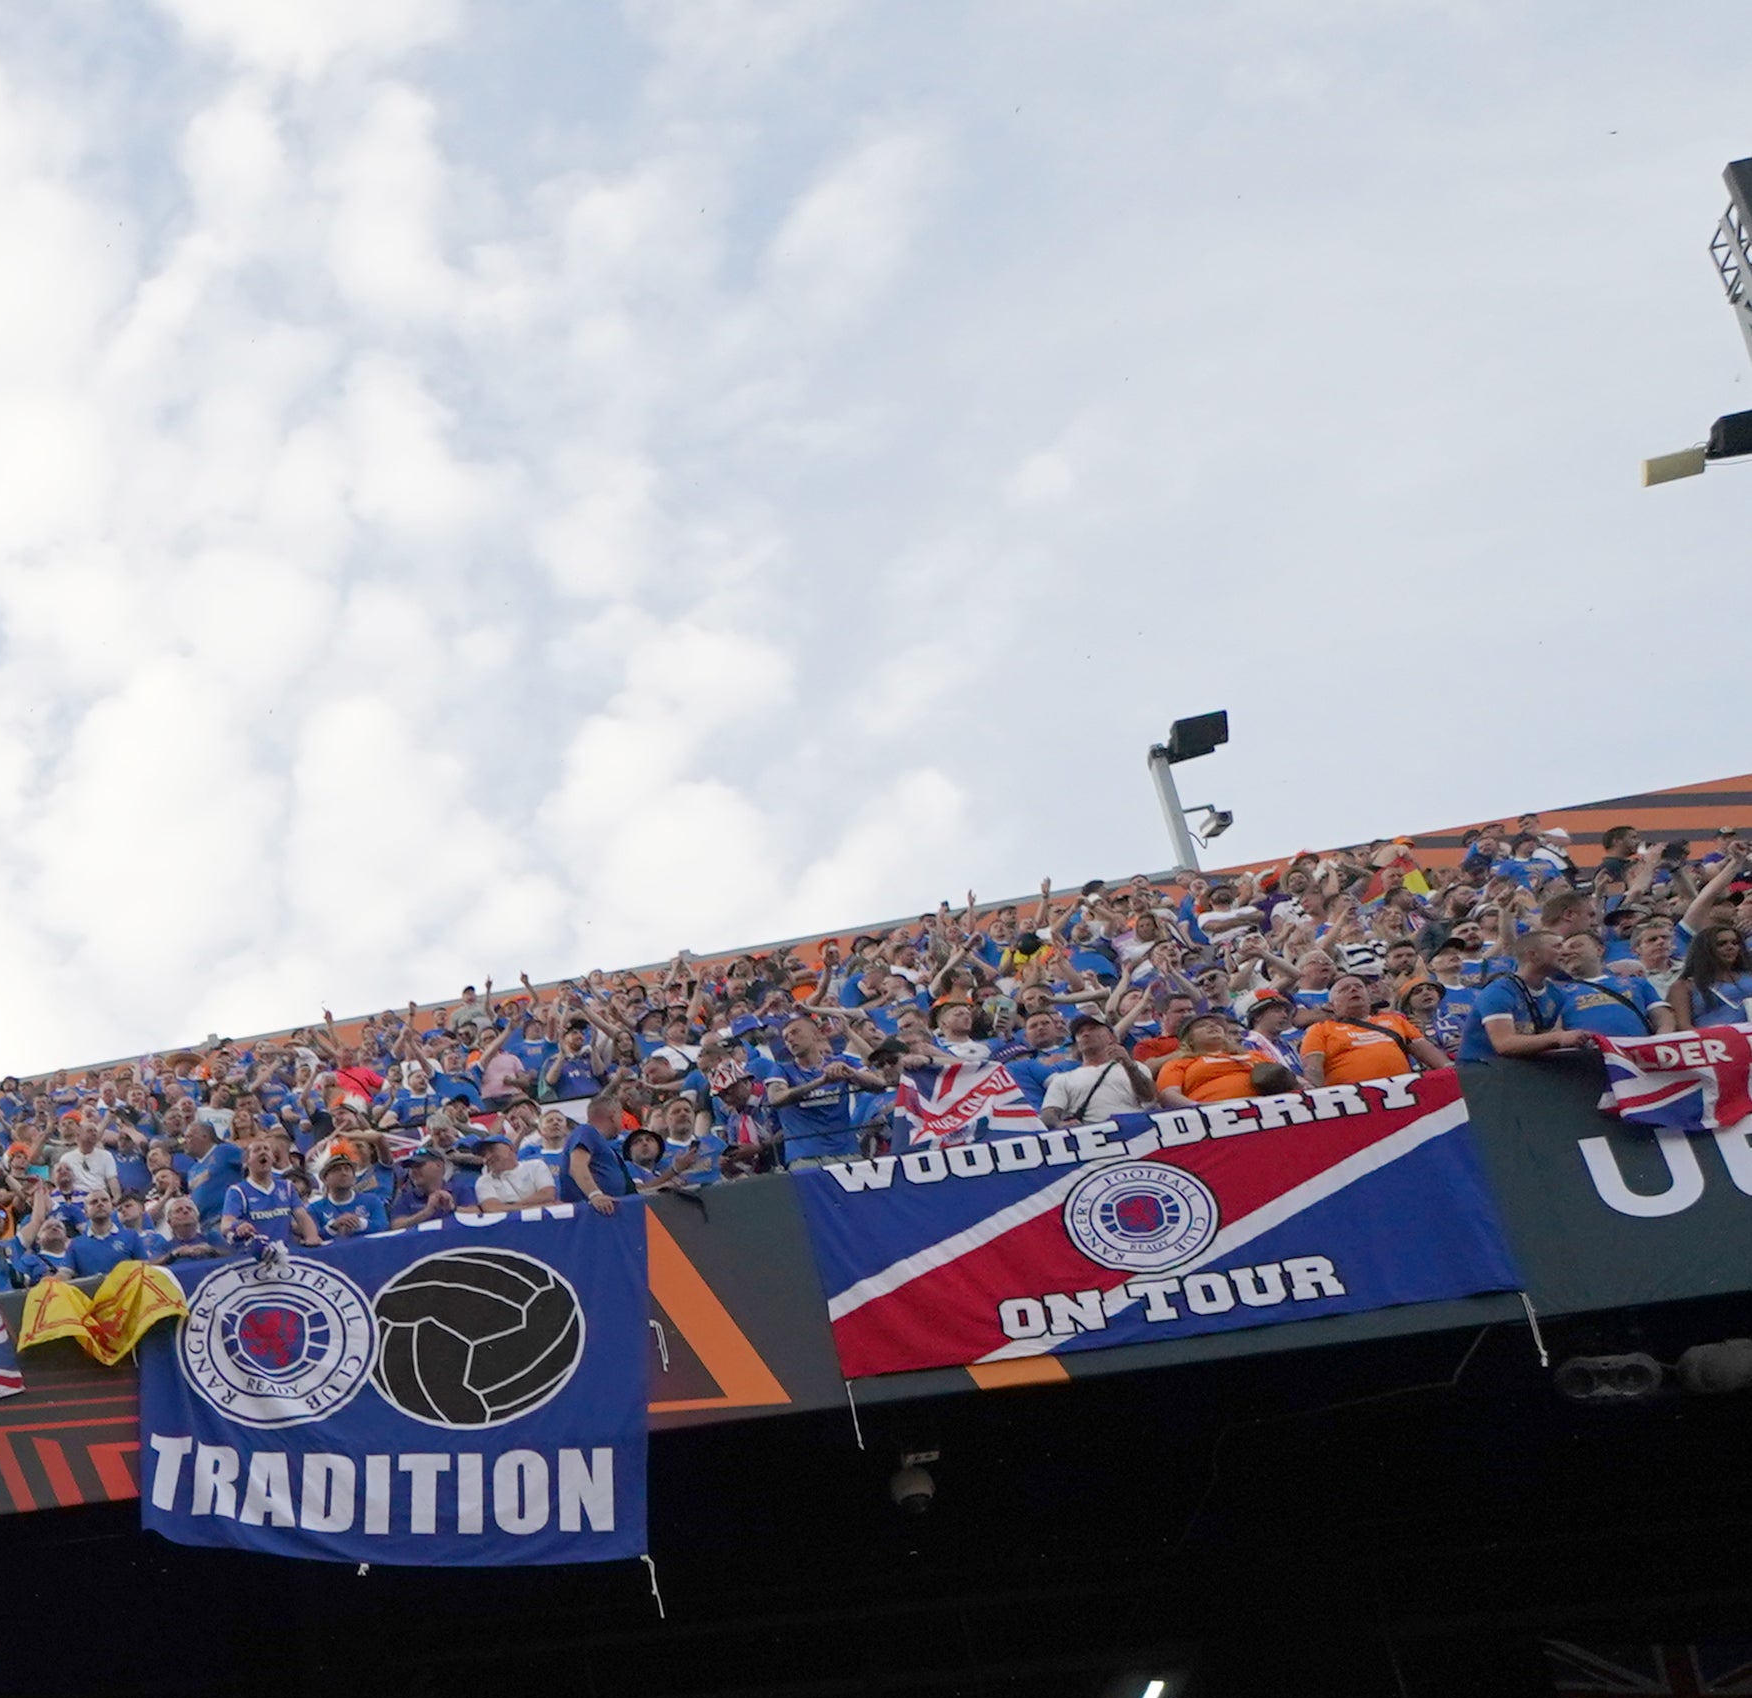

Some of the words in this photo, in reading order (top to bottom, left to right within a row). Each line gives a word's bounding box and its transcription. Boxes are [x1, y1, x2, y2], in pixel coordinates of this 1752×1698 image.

[828, 1120, 1129, 1192] WOODIE
[1150, 1071, 1421, 1147] DERRY
[999, 1293, 1113, 1340] ON
[1121, 1255, 1346, 1324] TOUR
[186, 1290, 237, 1405] RANGERS
[246, 1376, 301, 1394] READY
[306, 1355, 363, 1410] CLUB
[150, 1432, 616, 1534] TRADITION
